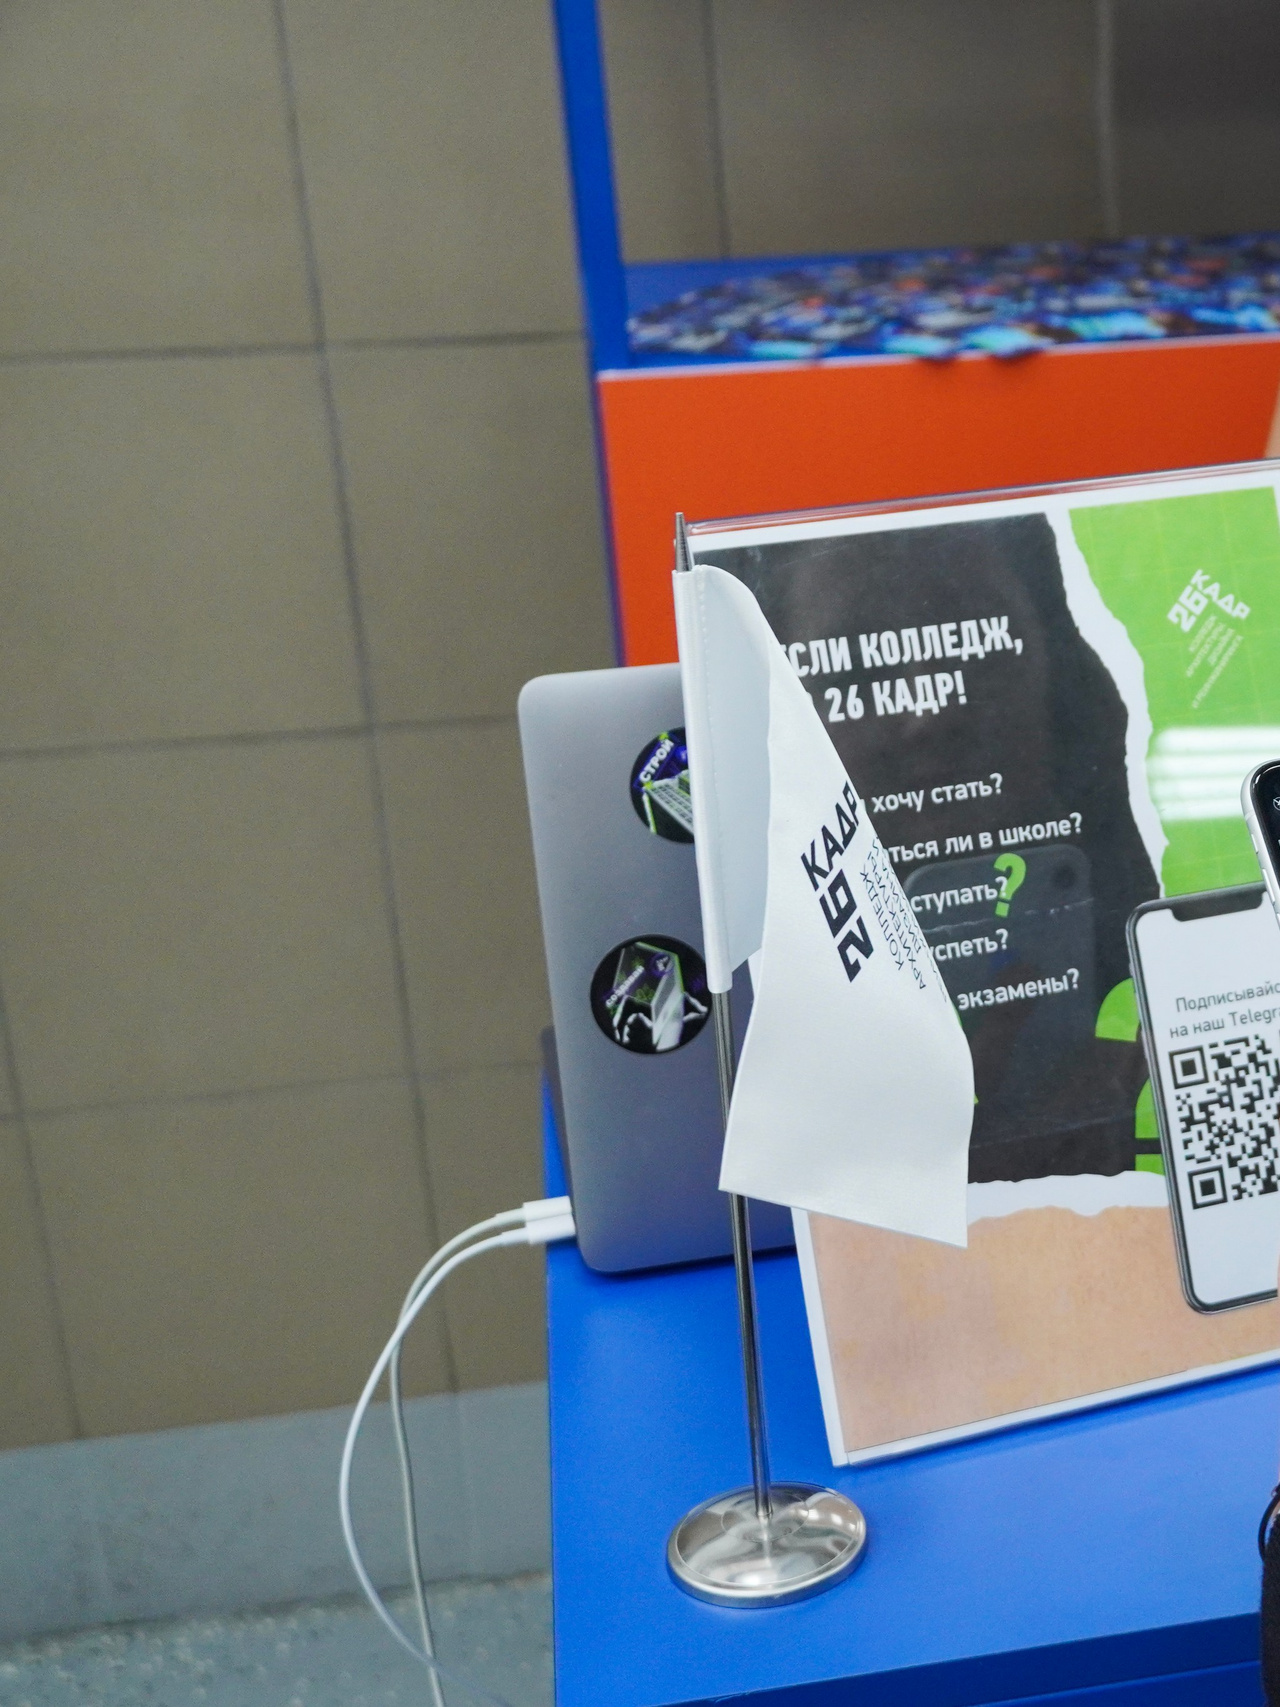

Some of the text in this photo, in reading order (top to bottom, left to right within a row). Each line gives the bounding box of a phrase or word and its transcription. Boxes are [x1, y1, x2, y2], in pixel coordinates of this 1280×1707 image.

[1166, 584, 1209, 634] 26
[1190, 568, 1252, 620] КАДР
[858, 614, 1024, 670] КОЛЛЕДЖ,
[823, 669, 968, 724] 26 КАДР!
[871, 772, 1004, 814] хочу стать?
[801, 779, 860, 892] КАДР
[887, 811, 1083, 864] ться ли в школе?
[910, 875, 1009, 915] ступать?
[819, 867, 875, 984] 26
[956, 967, 1081, 1012] экзамены?
[1169, 1024, 1189, 1039] на
[1193, 1016, 1225, 1035] наш
